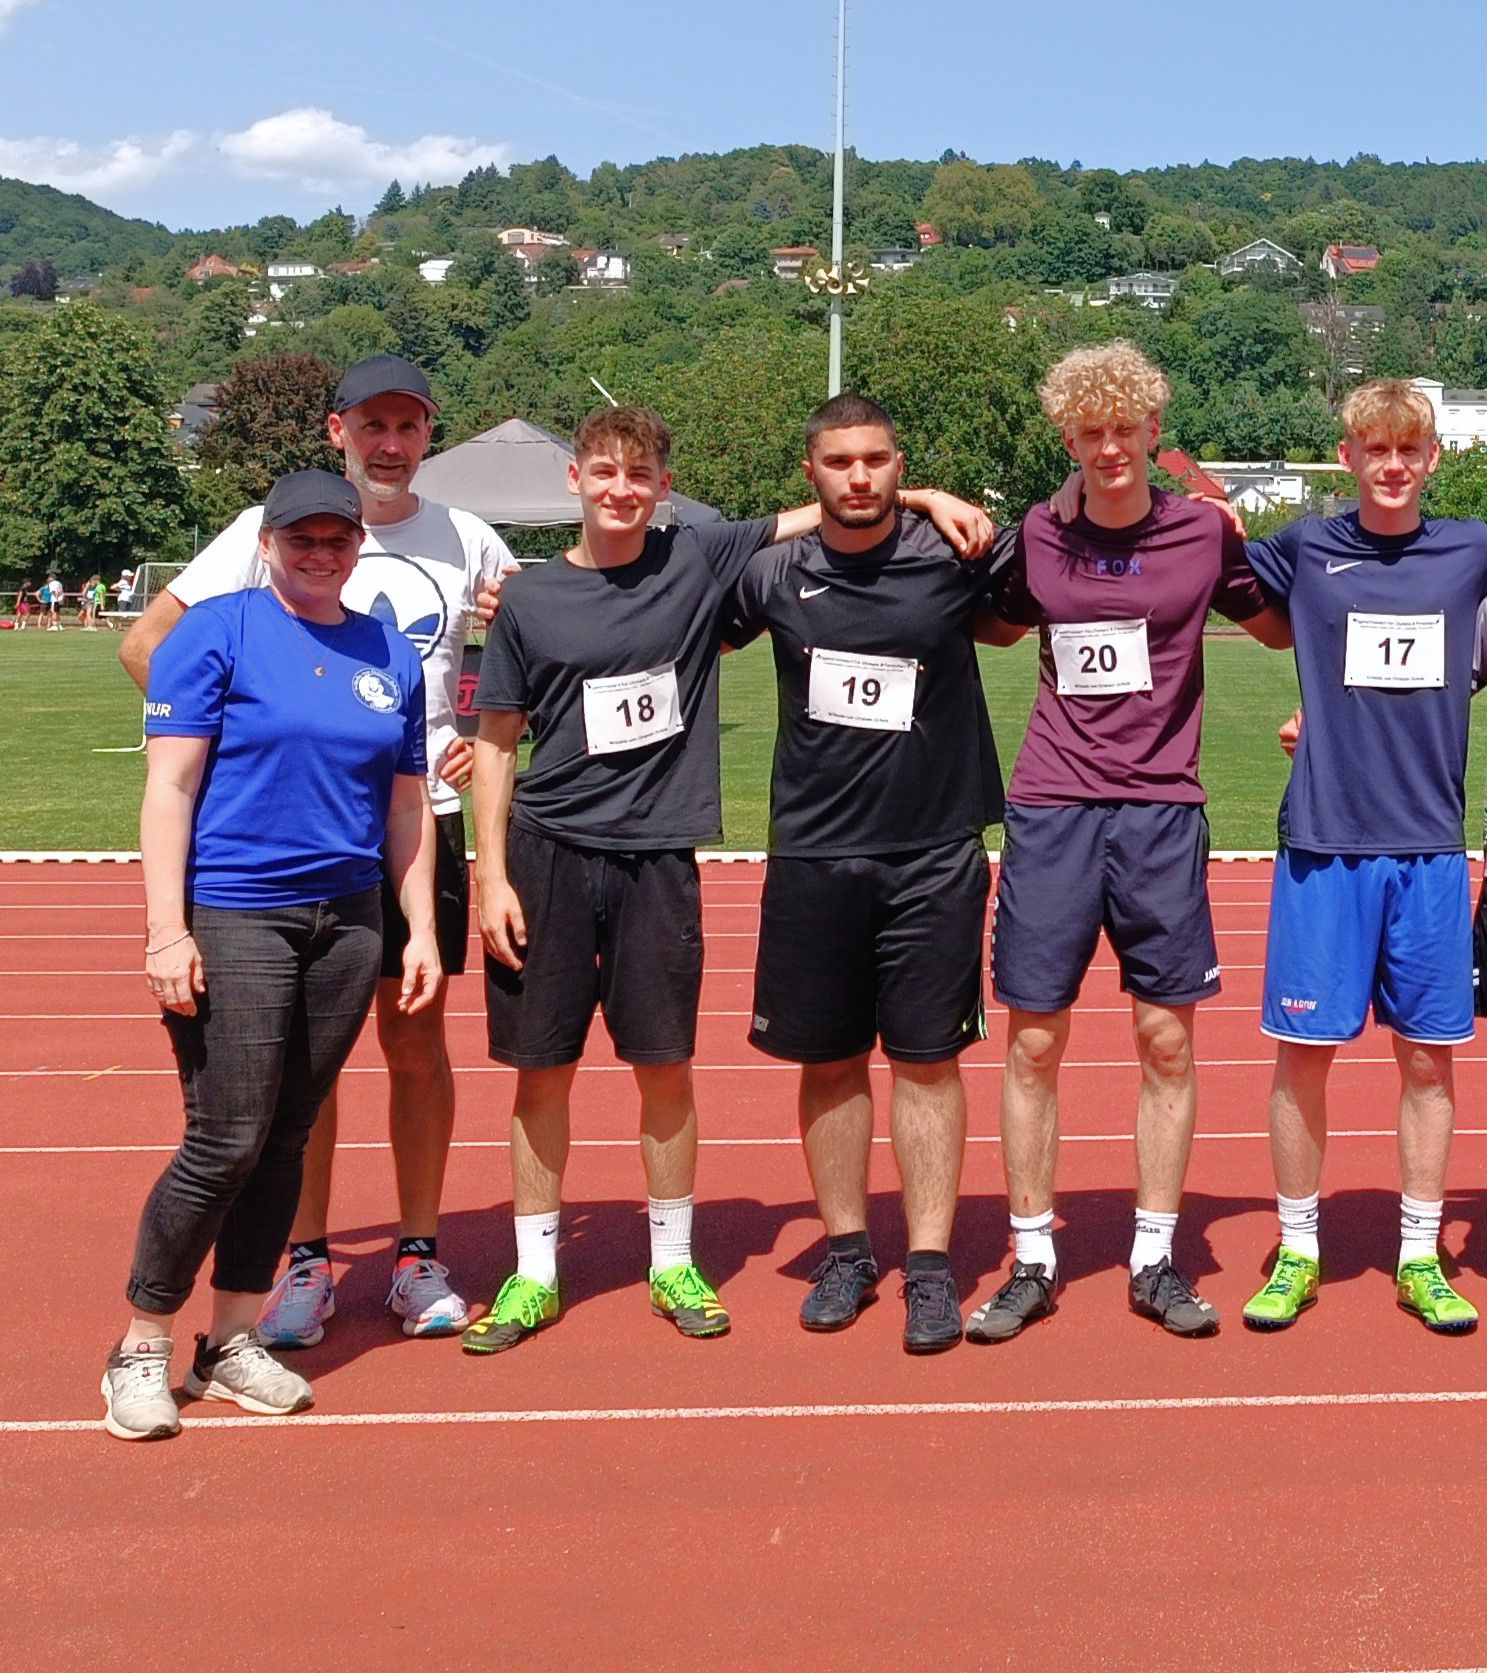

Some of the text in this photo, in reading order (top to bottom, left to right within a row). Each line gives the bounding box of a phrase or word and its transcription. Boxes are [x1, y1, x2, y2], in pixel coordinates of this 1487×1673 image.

[1096, 559, 1141, 576] FOX
[1078, 644, 1118, 673] 20
[1378, 637, 1415, 666] 17
[842, 676, 881, 706] 19
[616, 694, 655, 727] 18
